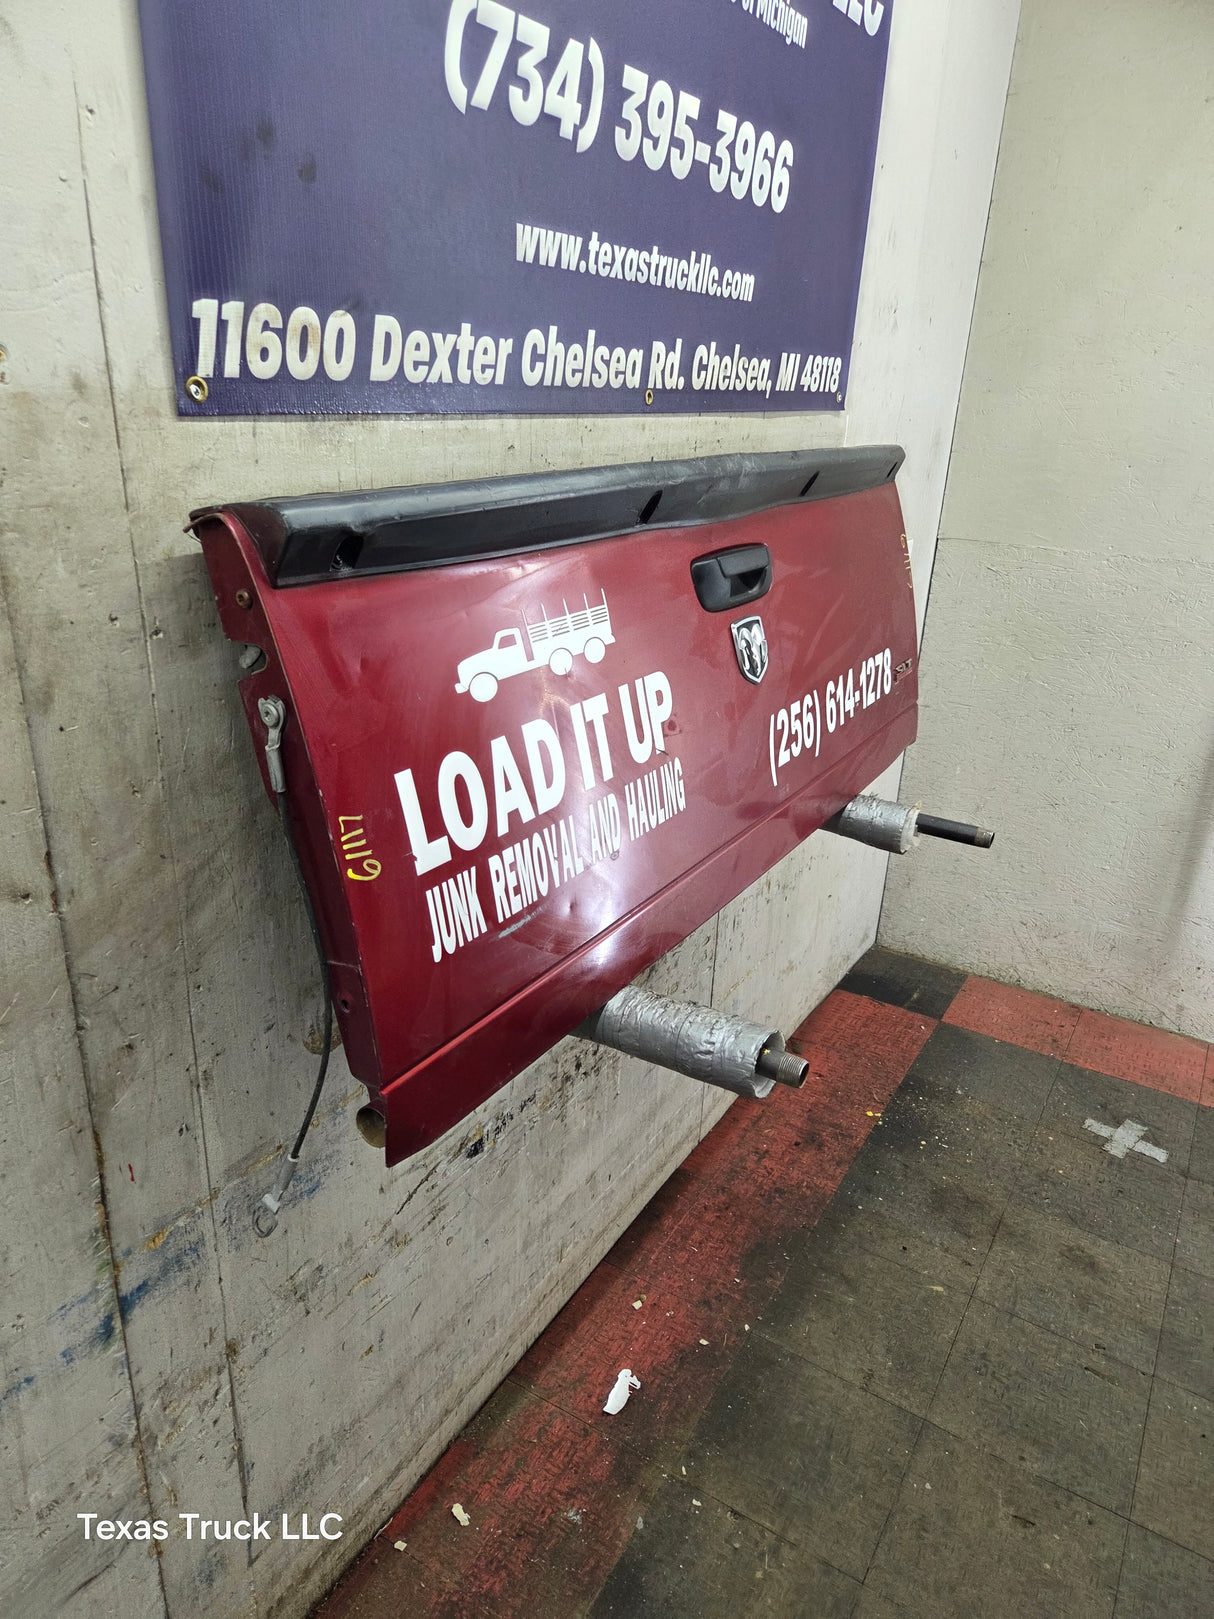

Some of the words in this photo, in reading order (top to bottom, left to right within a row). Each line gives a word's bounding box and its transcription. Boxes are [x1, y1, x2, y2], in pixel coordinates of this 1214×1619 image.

[444, 0, 605, 153] (734)
[614, 64, 794, 214] 395-3966
[191, 298, 357, 381] 11600
[370, 314, 513, 386] Dexter
[521, 325, 644, 389] Chelsea
[647, 338, 685, 390] Rd.
[691, 341, 773, 399] Chelsea,
[775, 352, 801, 392] MI
[799, 354, 842, 393] 48118
[515, 222, 755, 302] www.texastruckllc.com
[394, 717, 567, 877] LOAD
[569, 693, 615, 792] IT
[618, 671, 674, 765] UP
[768, 689, 822, 787] (256)
[825, 647, 892, 733] 614-1278
[425, 866, 488, 963] JUNK
[488, 814, 585, 924] REMOVAL
[588, 792, 622, 866] AND
[624, 756, 687, 842] HAULING
